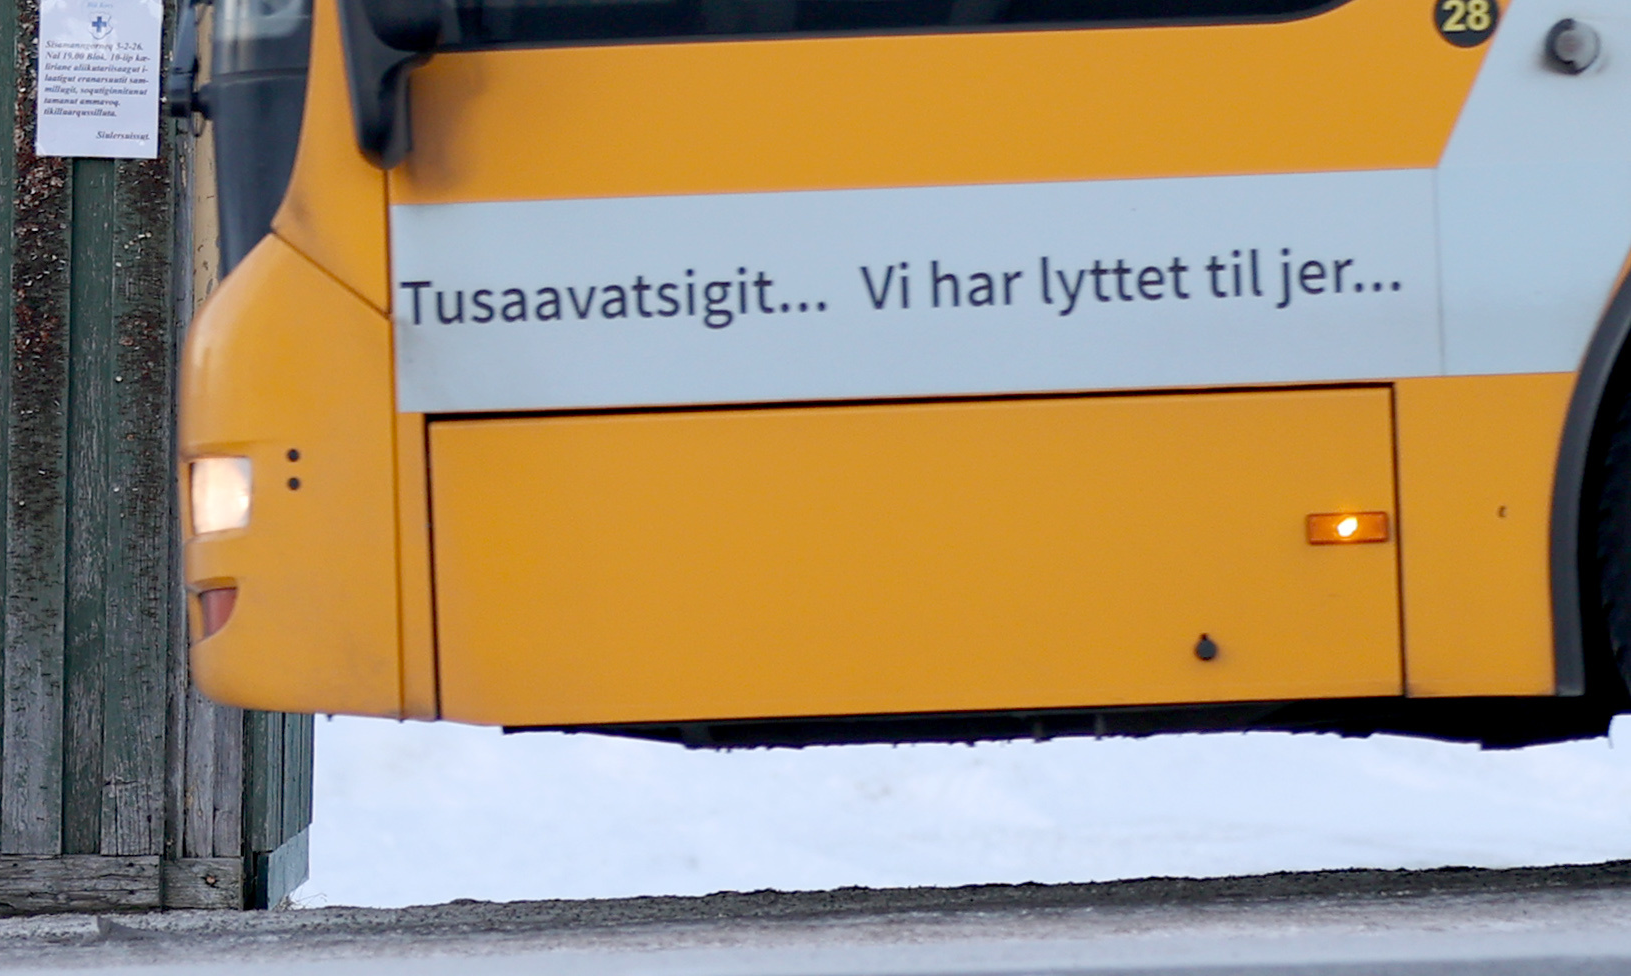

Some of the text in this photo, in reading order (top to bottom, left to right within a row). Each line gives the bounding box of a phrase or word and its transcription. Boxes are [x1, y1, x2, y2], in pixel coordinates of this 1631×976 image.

[399, 247, 1402, 330] Tusaavatsigit... Vi har lyttet til jer...
